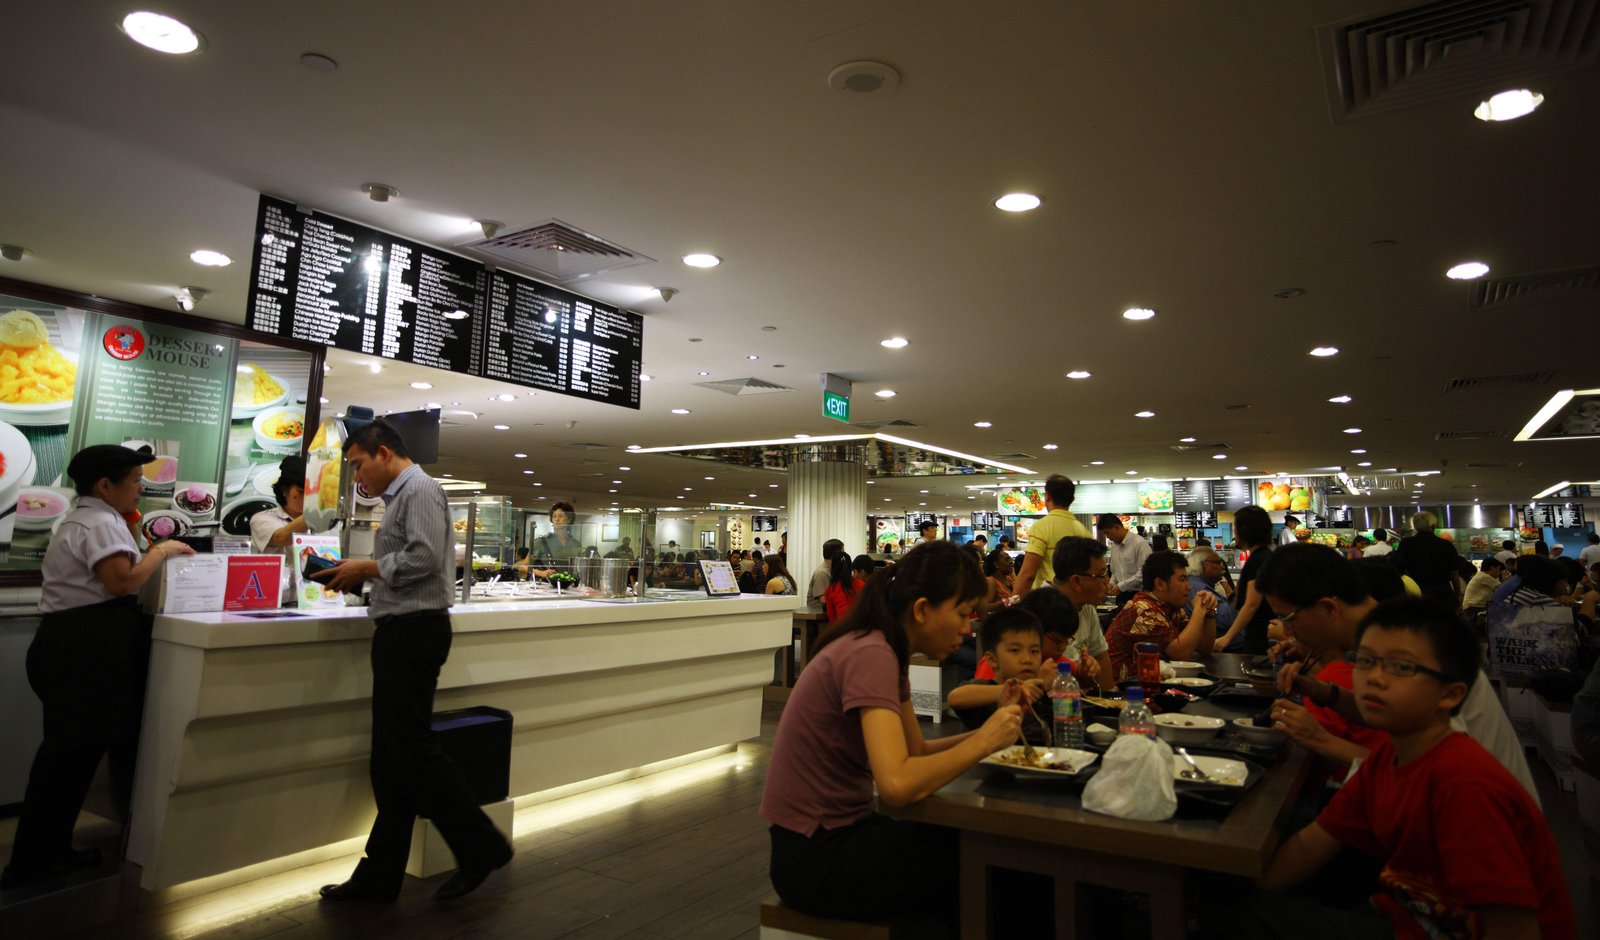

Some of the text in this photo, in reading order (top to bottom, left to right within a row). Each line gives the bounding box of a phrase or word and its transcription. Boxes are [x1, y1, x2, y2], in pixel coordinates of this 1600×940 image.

[312, 260, 326, 268] Chow
[297, 292, 315, 301] Almond
[295, 309, 314, 318] Chinese
[294, 315, 311, 324] Mango
[146, 348, 210, 369] MOUSE
[831, 398, 847, 418] EXIT
[238, 570, 266, 599] A
[1495, 637, 1538, 648] WALK
[1496, 646, 1526, 655] THE
[1497, 655, 1536, 665] TALK
